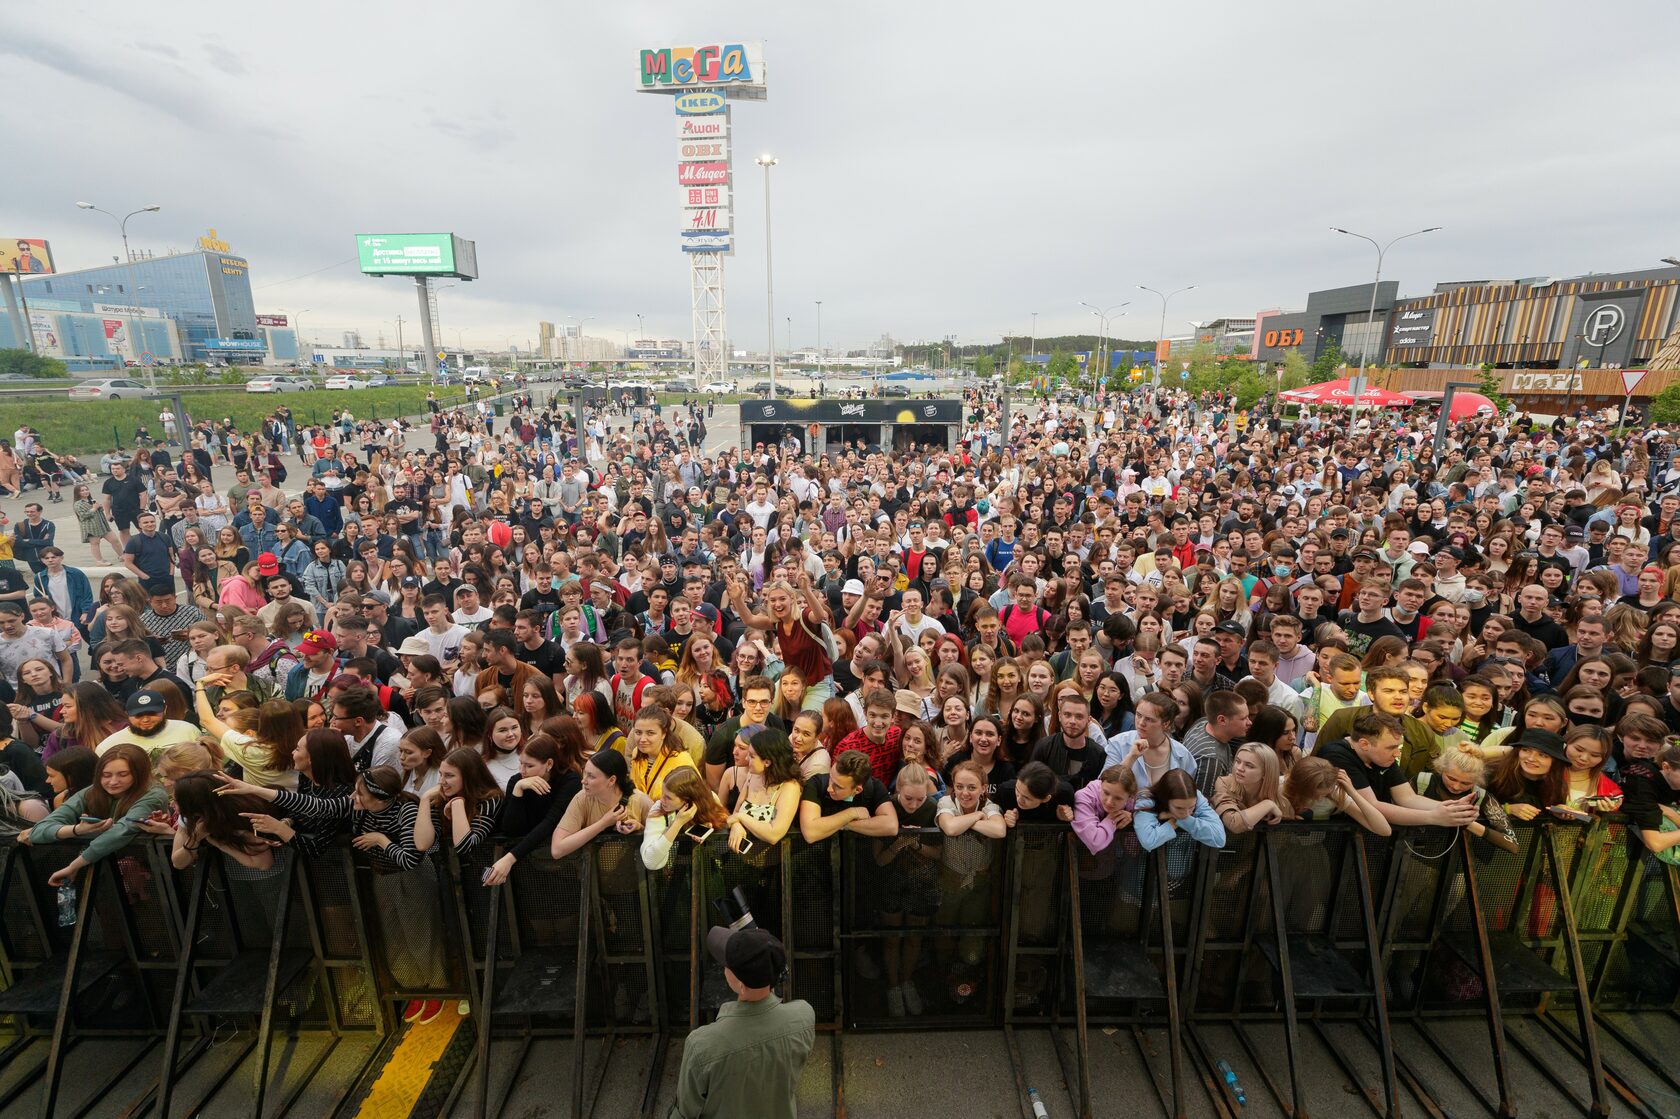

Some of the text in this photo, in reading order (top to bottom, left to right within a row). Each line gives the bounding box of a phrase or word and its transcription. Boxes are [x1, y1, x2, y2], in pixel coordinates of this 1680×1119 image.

[682, 98, 720, 108] IKEA
[681, 143, 722, 157] OBI
[692, 209, 717, 228] H&M
[1590, 310, 1619, 341] P
[1264, 328, 1304, 348] ОБИ
[36, 703, 51, 712] BIN
